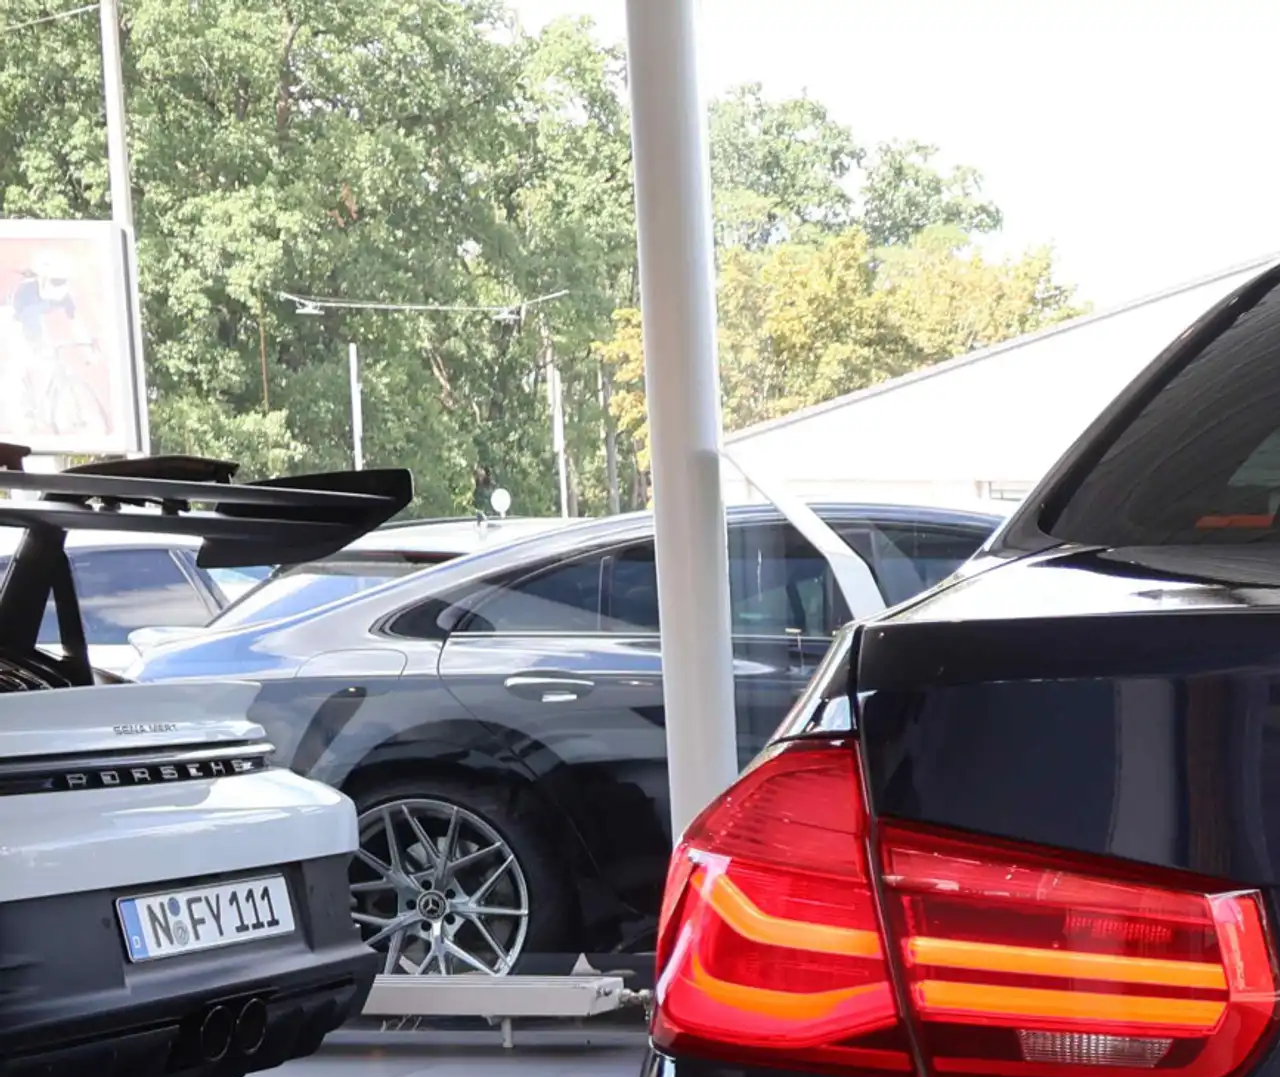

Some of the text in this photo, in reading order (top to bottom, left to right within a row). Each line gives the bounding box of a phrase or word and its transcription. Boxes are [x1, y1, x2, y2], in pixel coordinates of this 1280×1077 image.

[66, 759, 250, 789] PORSCHE
[147, 885, 280, 949] N FY 111
